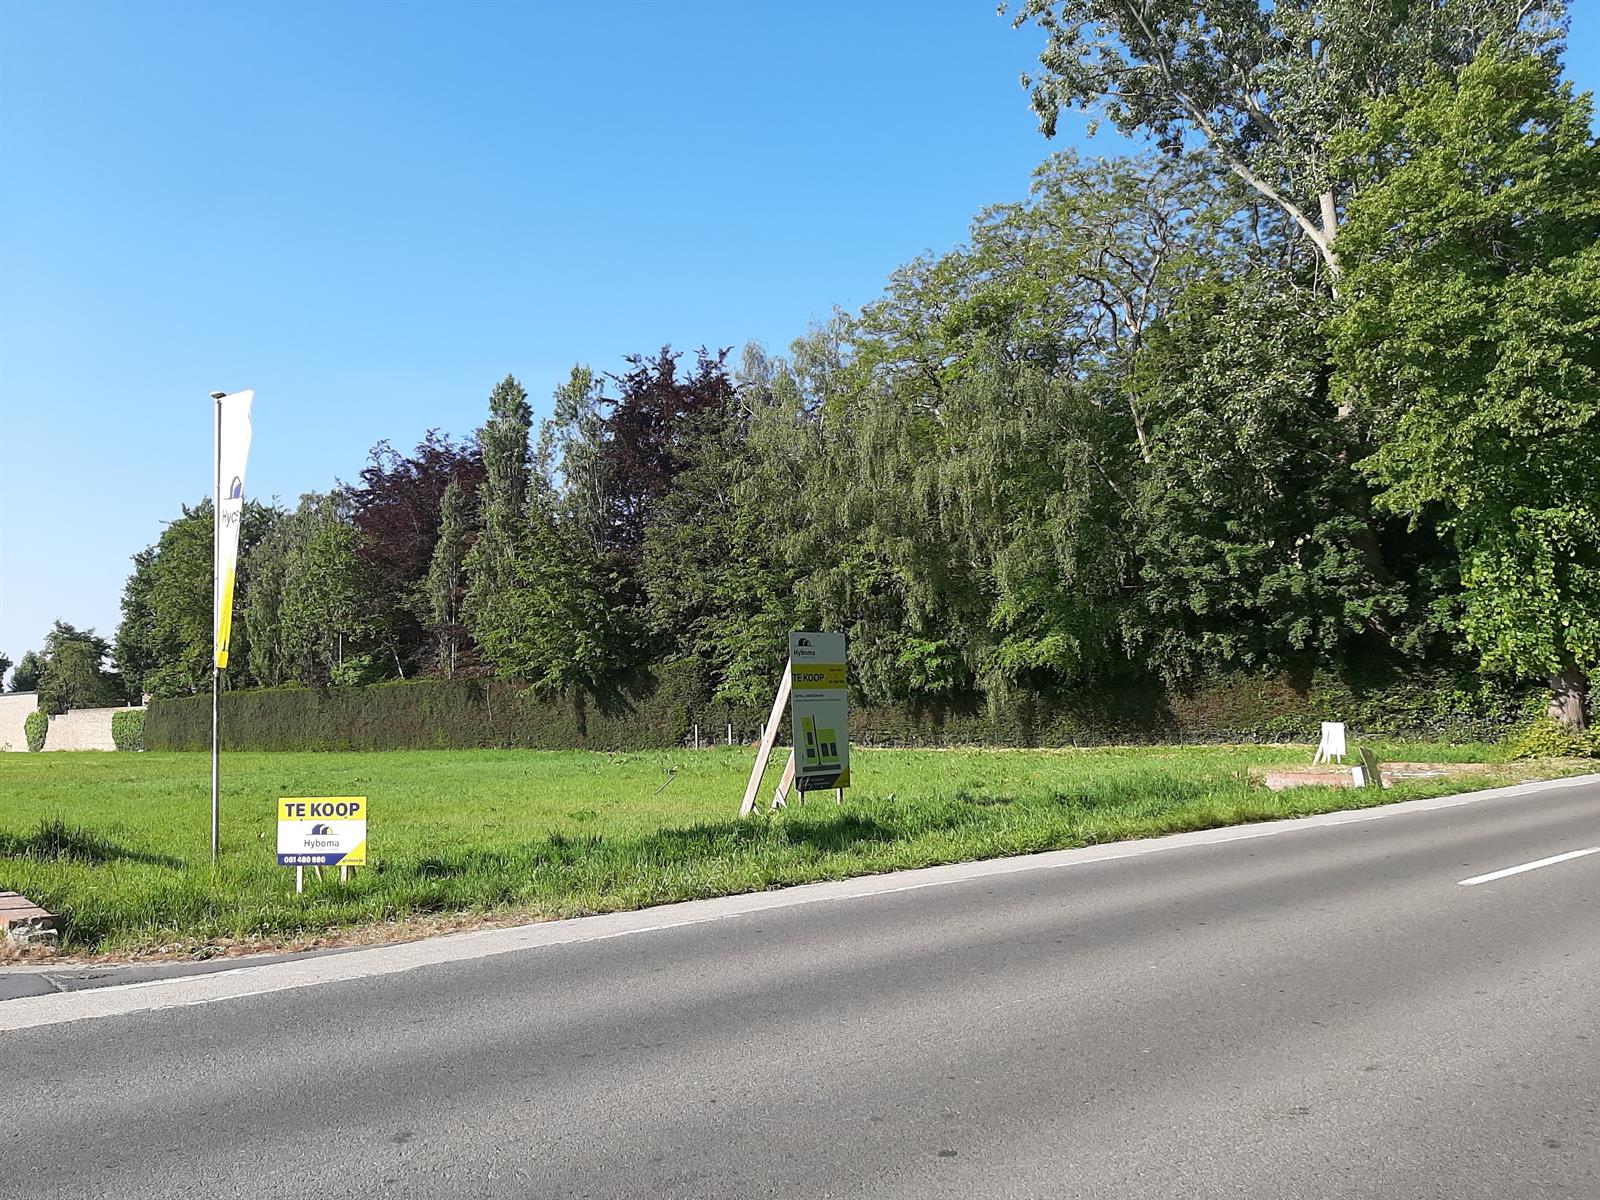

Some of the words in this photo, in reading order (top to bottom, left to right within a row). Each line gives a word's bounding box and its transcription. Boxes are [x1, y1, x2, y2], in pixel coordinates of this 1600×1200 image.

[792, 673, 802, 682] TE
[803, 673, 825, 682] KOOP
[285, 803, 306, 817] TE
[310, 802, 360, 817] KOOP
[303, 839, 340, 849] Hyboma
